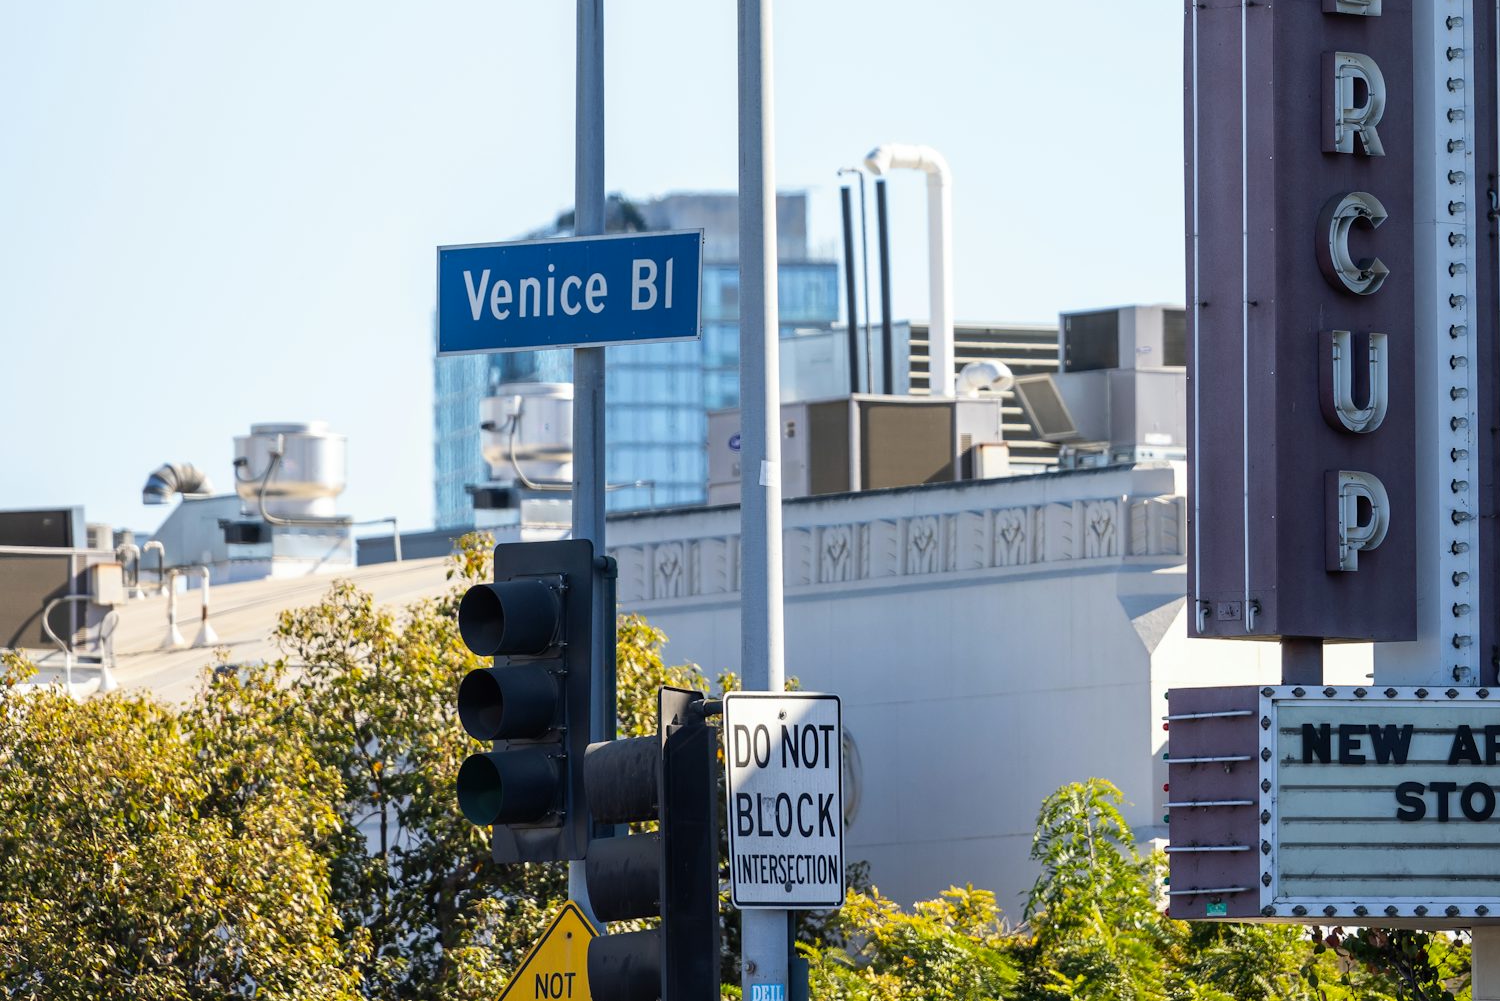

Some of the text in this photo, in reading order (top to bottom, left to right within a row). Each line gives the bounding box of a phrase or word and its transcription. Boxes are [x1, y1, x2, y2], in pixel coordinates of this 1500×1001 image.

[463, 257, 674, 321] Venice Bl
[734, 723, 835, 769] DO NOT
[1302, 723, 1414, 764] NEW
[736, 792, 836, 838] BLOCK
[737, 854, 838, 885] INTERSECTION
[535, 972, 577, 1000] NOT
